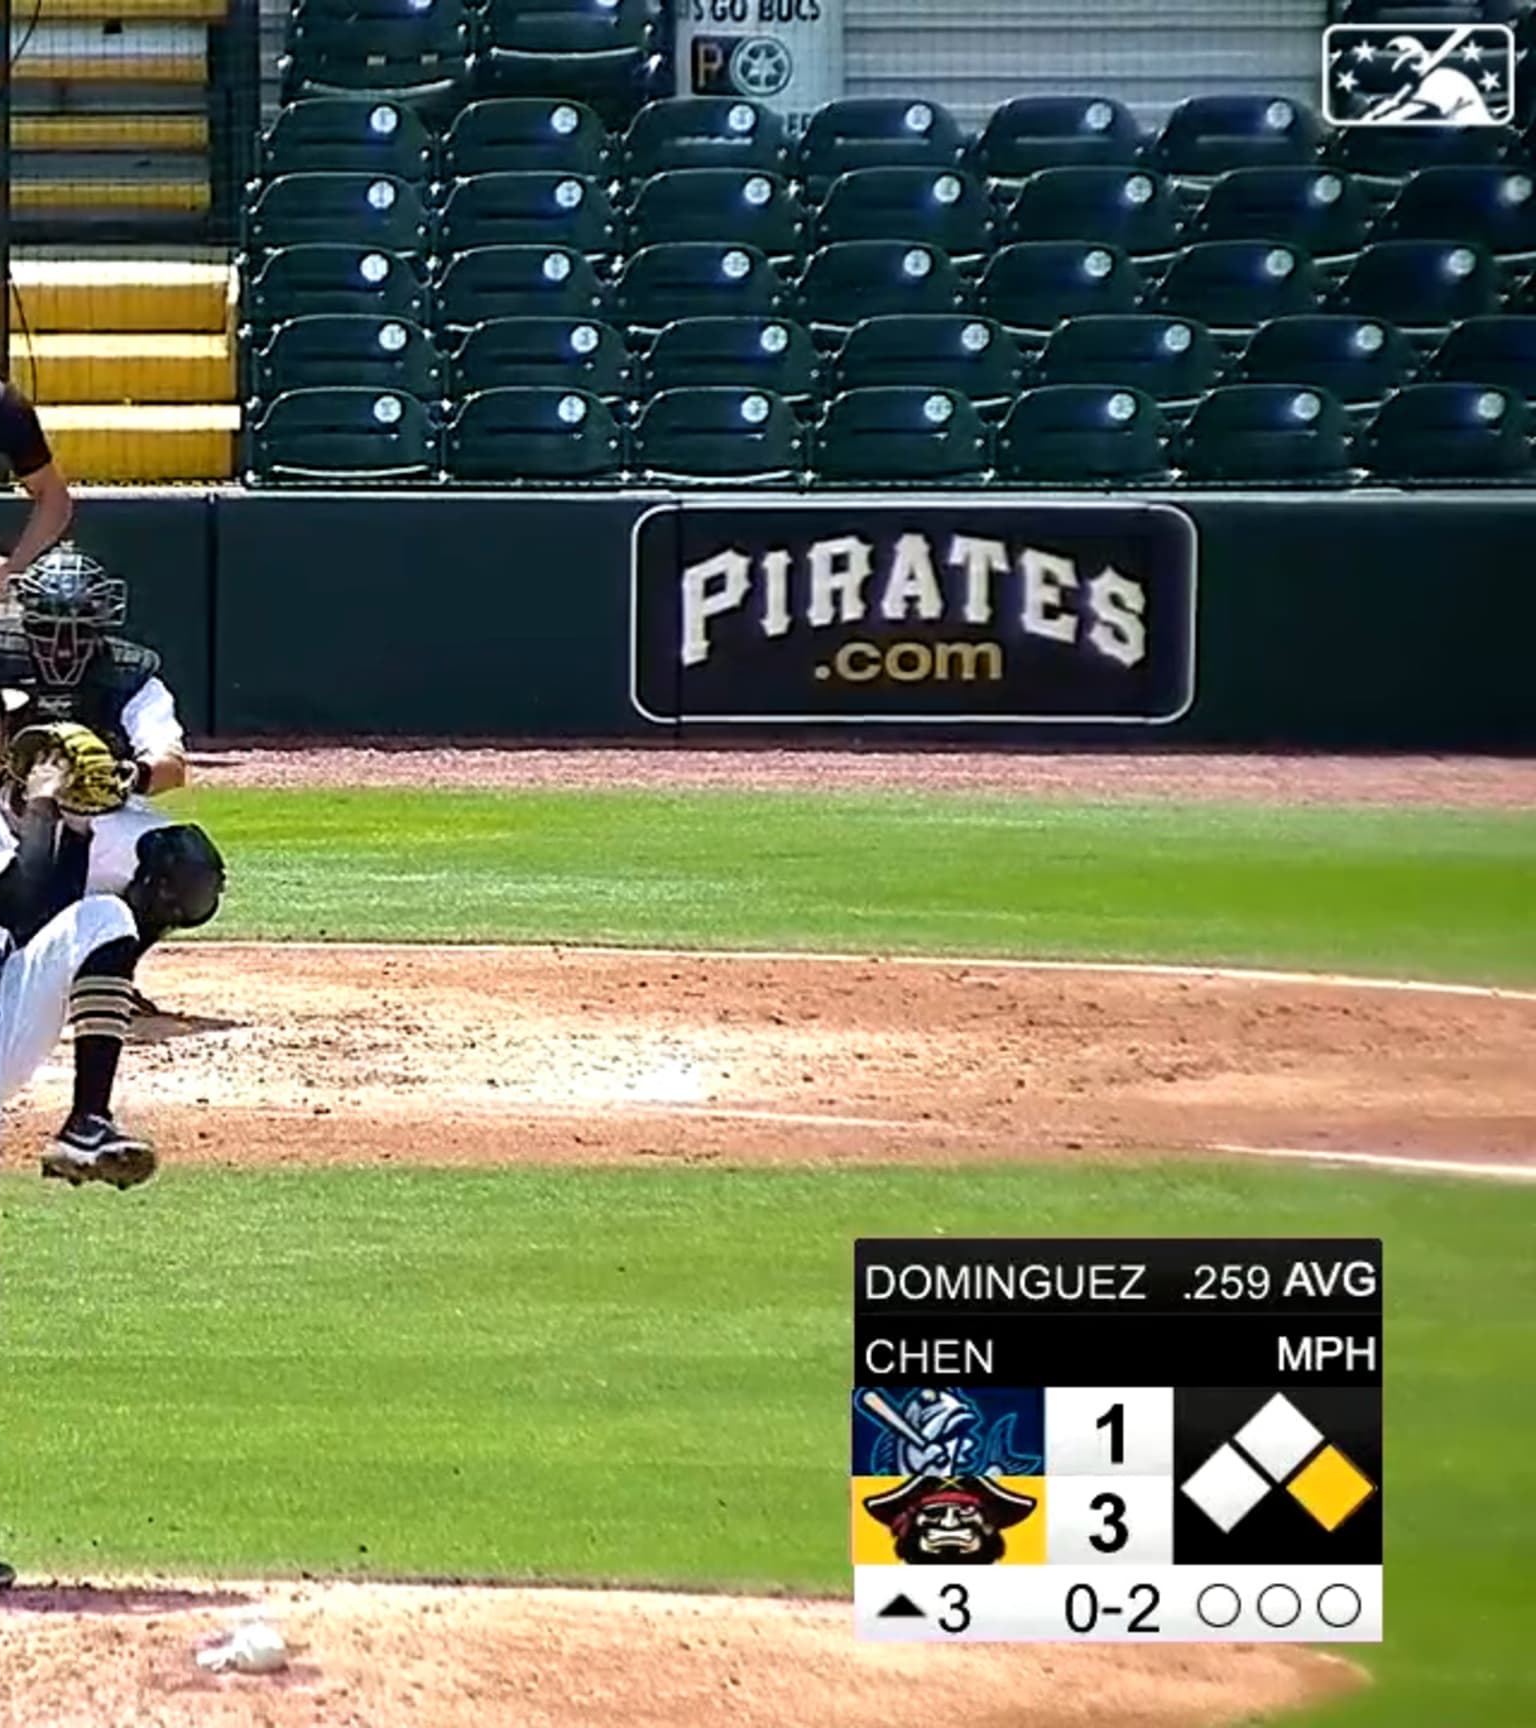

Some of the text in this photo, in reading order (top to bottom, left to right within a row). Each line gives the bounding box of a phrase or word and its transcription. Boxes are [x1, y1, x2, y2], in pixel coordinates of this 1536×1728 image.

[711, 0, 747, 22] GO
[758, 0, 820, 22] BUCS
[681, 533, 1148, 667] PIRATES
[814, 641, 1003, 681] .com
